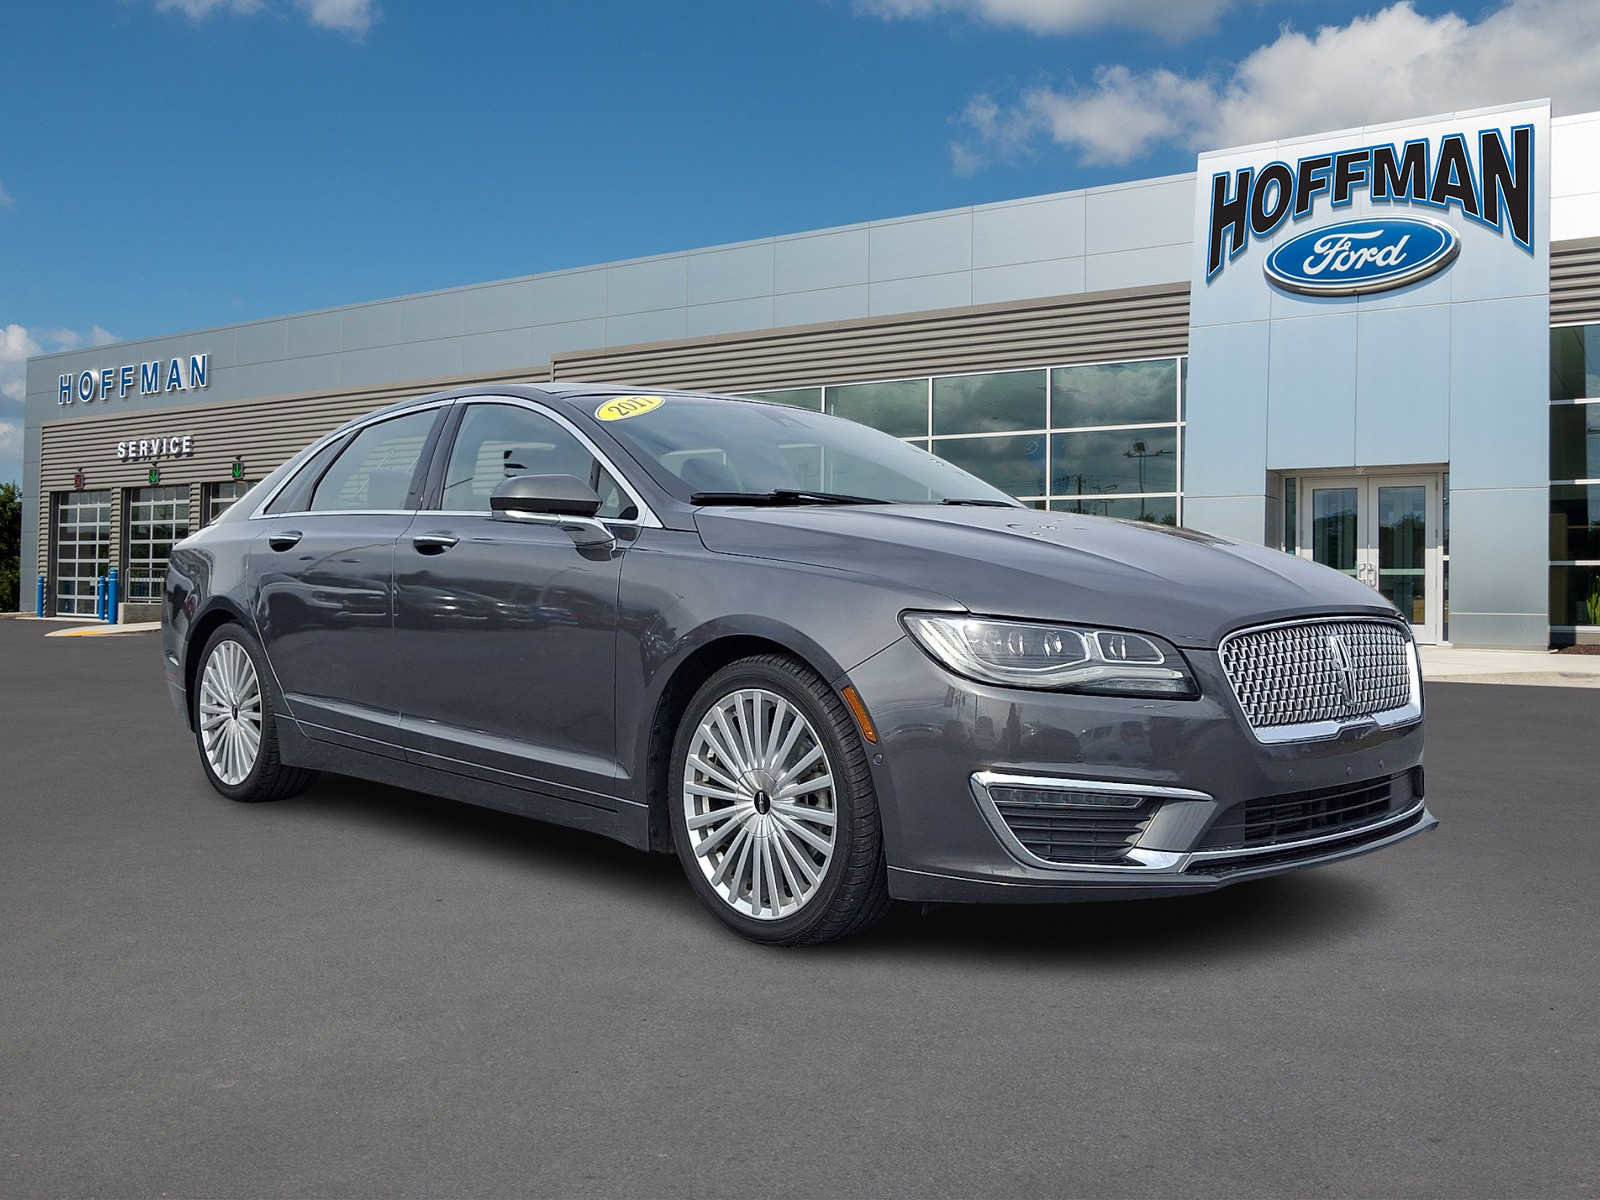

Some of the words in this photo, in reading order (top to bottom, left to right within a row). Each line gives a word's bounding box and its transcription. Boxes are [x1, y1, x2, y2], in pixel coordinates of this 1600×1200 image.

[1206, 123, 1535, 283] HOFFMAN
[1303, 229, 1411, 276] Ford
[58, 353, 208, 405] HOFFMAN
[608, 397, 654, 416] 2017
[117, 435, 192, 458] SERVICE
